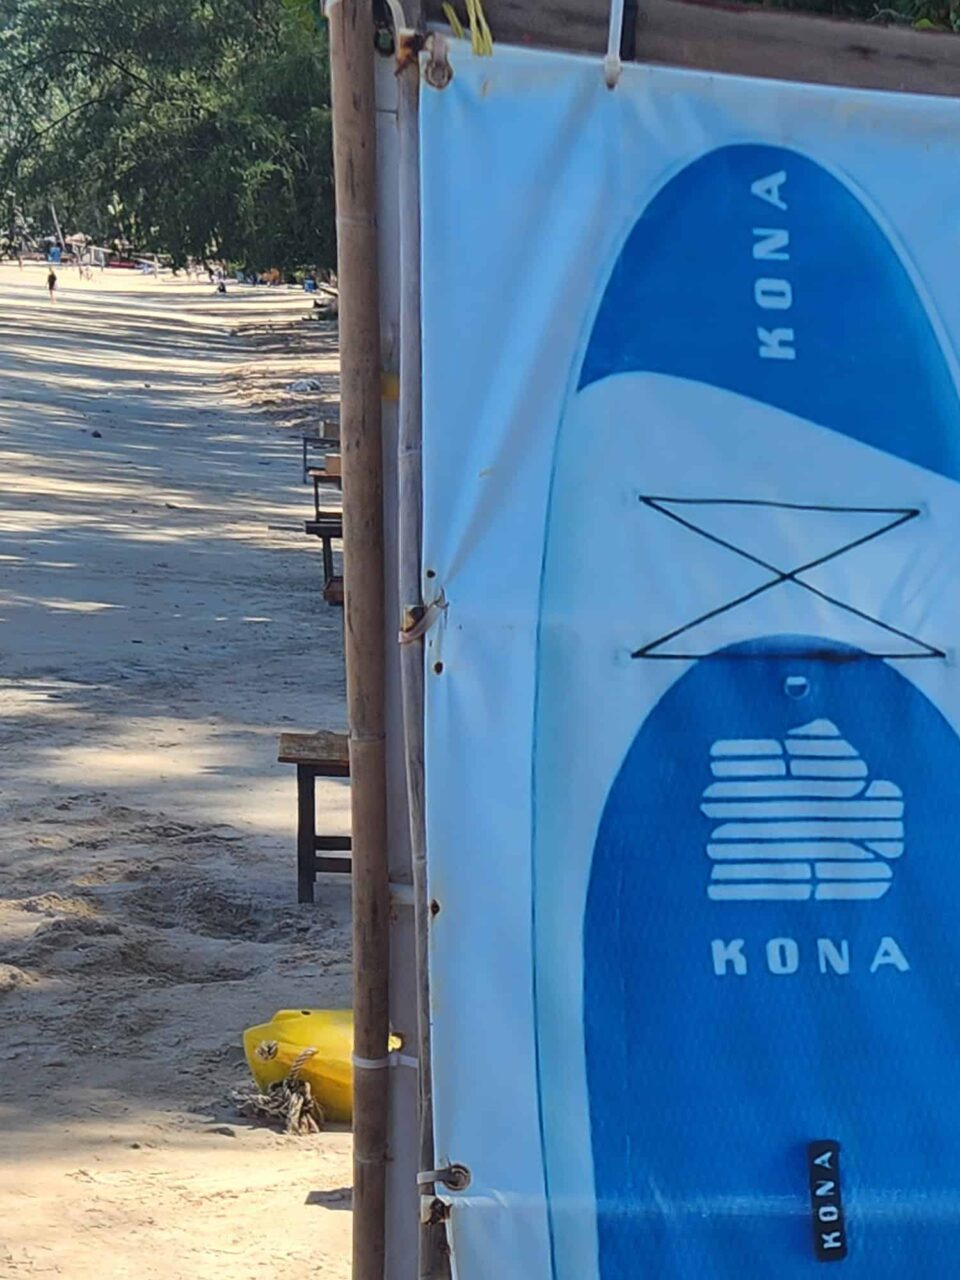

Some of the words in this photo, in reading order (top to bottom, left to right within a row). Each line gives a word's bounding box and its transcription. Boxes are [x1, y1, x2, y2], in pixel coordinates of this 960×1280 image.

[751, 169, 796, 360] KONA
[711, 936, 911, 975] KONA
[814, 1151, 842, 1249] KONA
